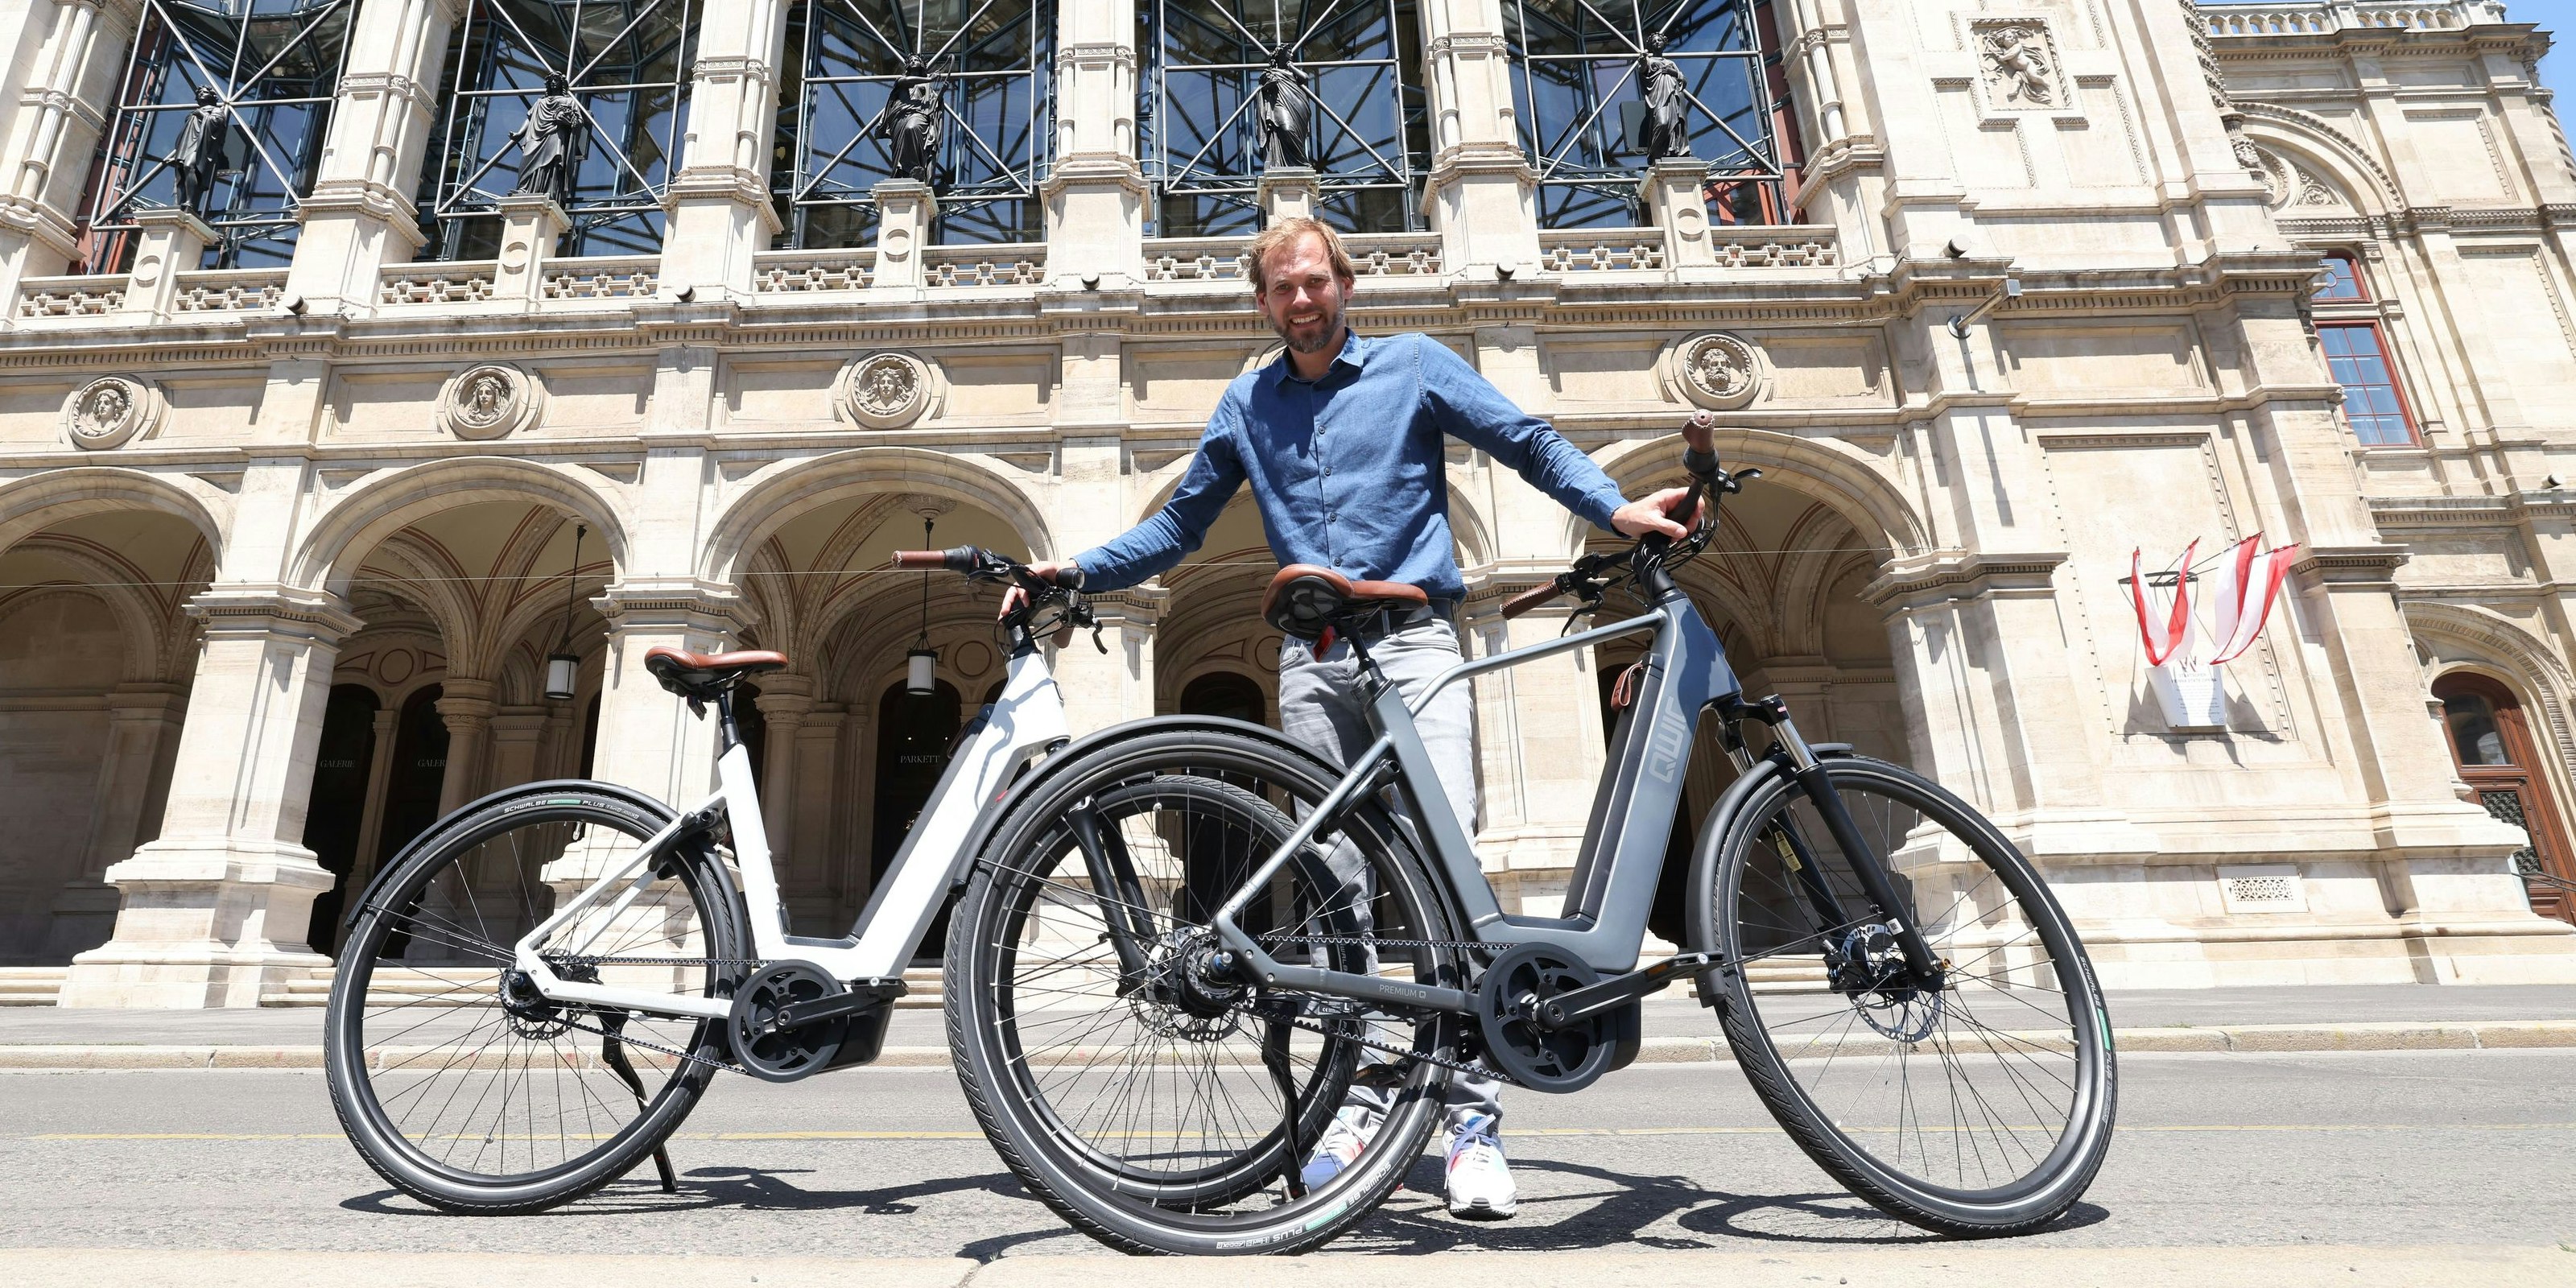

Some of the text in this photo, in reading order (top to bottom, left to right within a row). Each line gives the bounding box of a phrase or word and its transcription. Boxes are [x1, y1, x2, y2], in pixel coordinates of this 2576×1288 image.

[320, 759, 356, 768] GALERIE
[417, 758, 446, 768] GALER
[900, 755, 940, 763] PARKETT
[504, 799, 547, 814] SCHWALBE
[581, 800, 605, 808] PLUS
[1379, 984, 1418, 998] PREMIUM
[1344, 1002, 1350, 1011] L
[2079, 956, 2101, 1007] SCHWALBE
[2105, 1051, 2113, 1080] PLUS
[1348, 1162, 1392, 1206] SCHWALBE
[1273, 1225, 1303, 1243] PLUS
